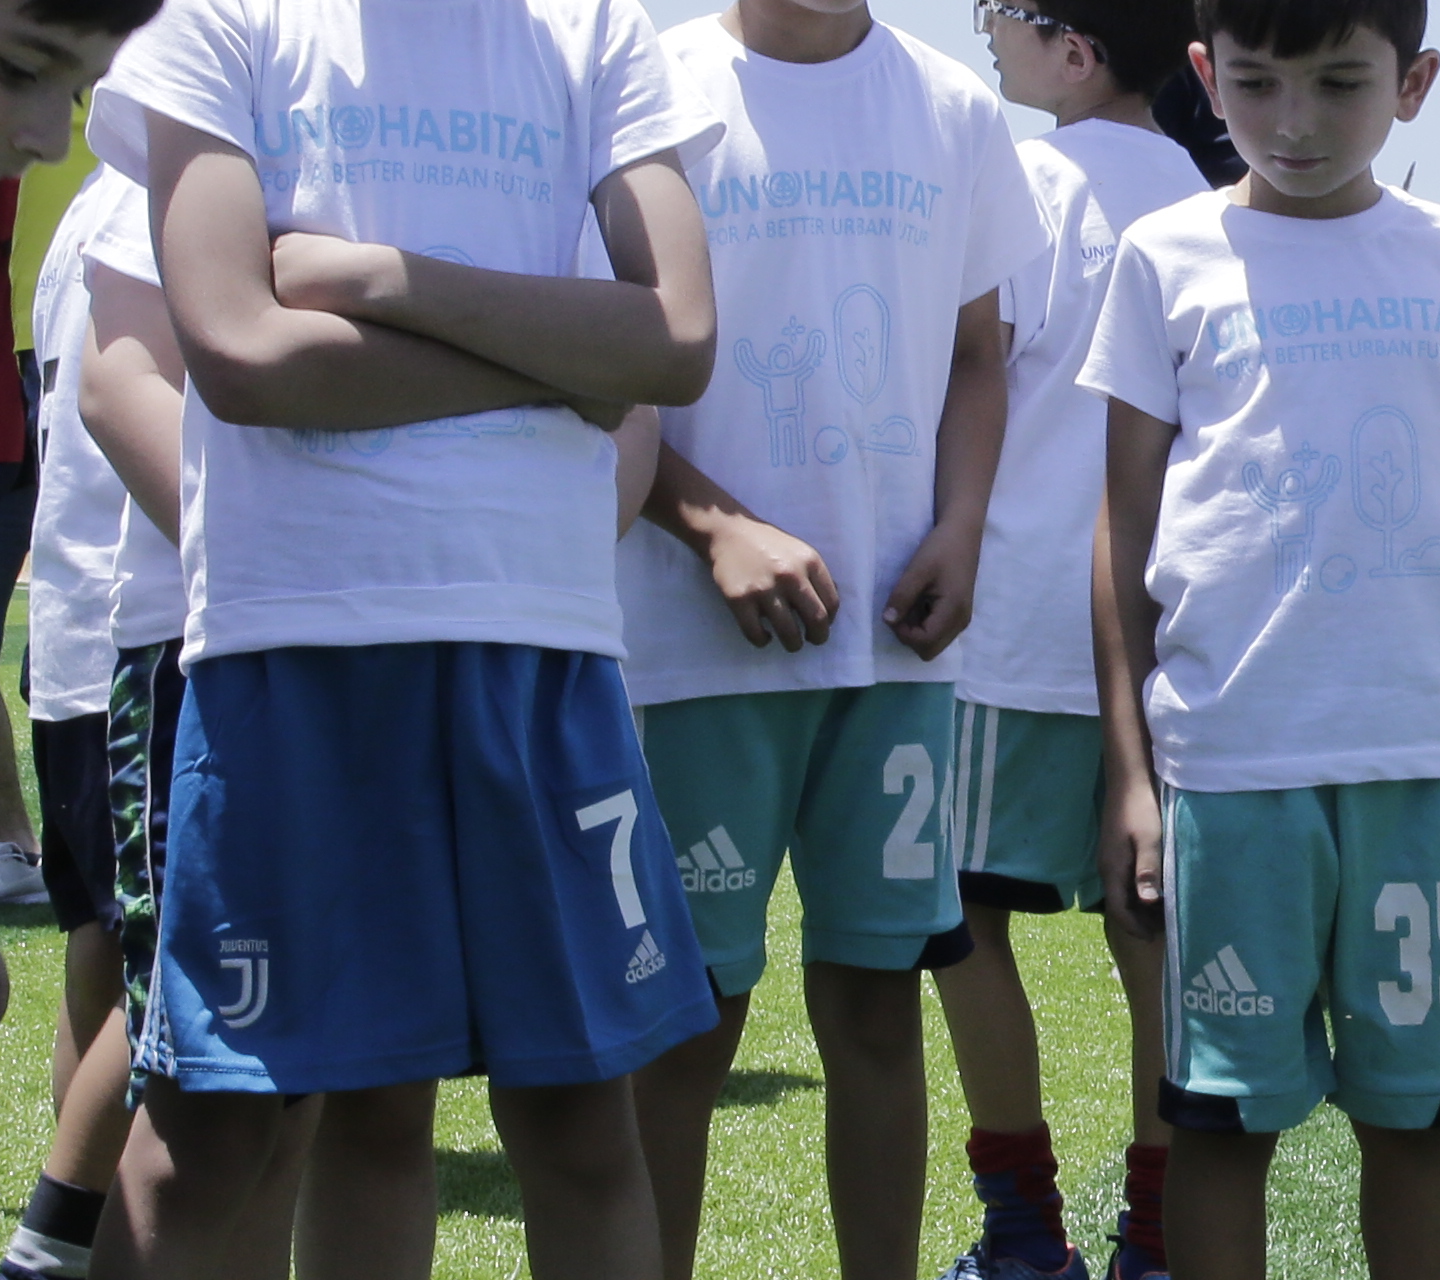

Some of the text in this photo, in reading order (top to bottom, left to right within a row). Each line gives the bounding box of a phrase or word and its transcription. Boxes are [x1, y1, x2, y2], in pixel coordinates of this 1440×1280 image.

[333, 160, 405, 185] BETTER
[412, 162, 488, 188] URBAN
[805, 171, 943, 220] HABITAT
[746, 224, 760, 241] A
[766, 217, 825, 238] BETTER
[831, 218, 892, 236] URBAN
[1275, 342, 1342, 365] BETTER
[1348, 339, 1413, 358] URBAN
[575, 788, 647, 930] 7
[681, 869, 756, 892] didas
[220, 940, 268, 953] JUVENTUS
[625, 953, 666, 984] adidas
[1183, 988, 1274, 1017] adidas
